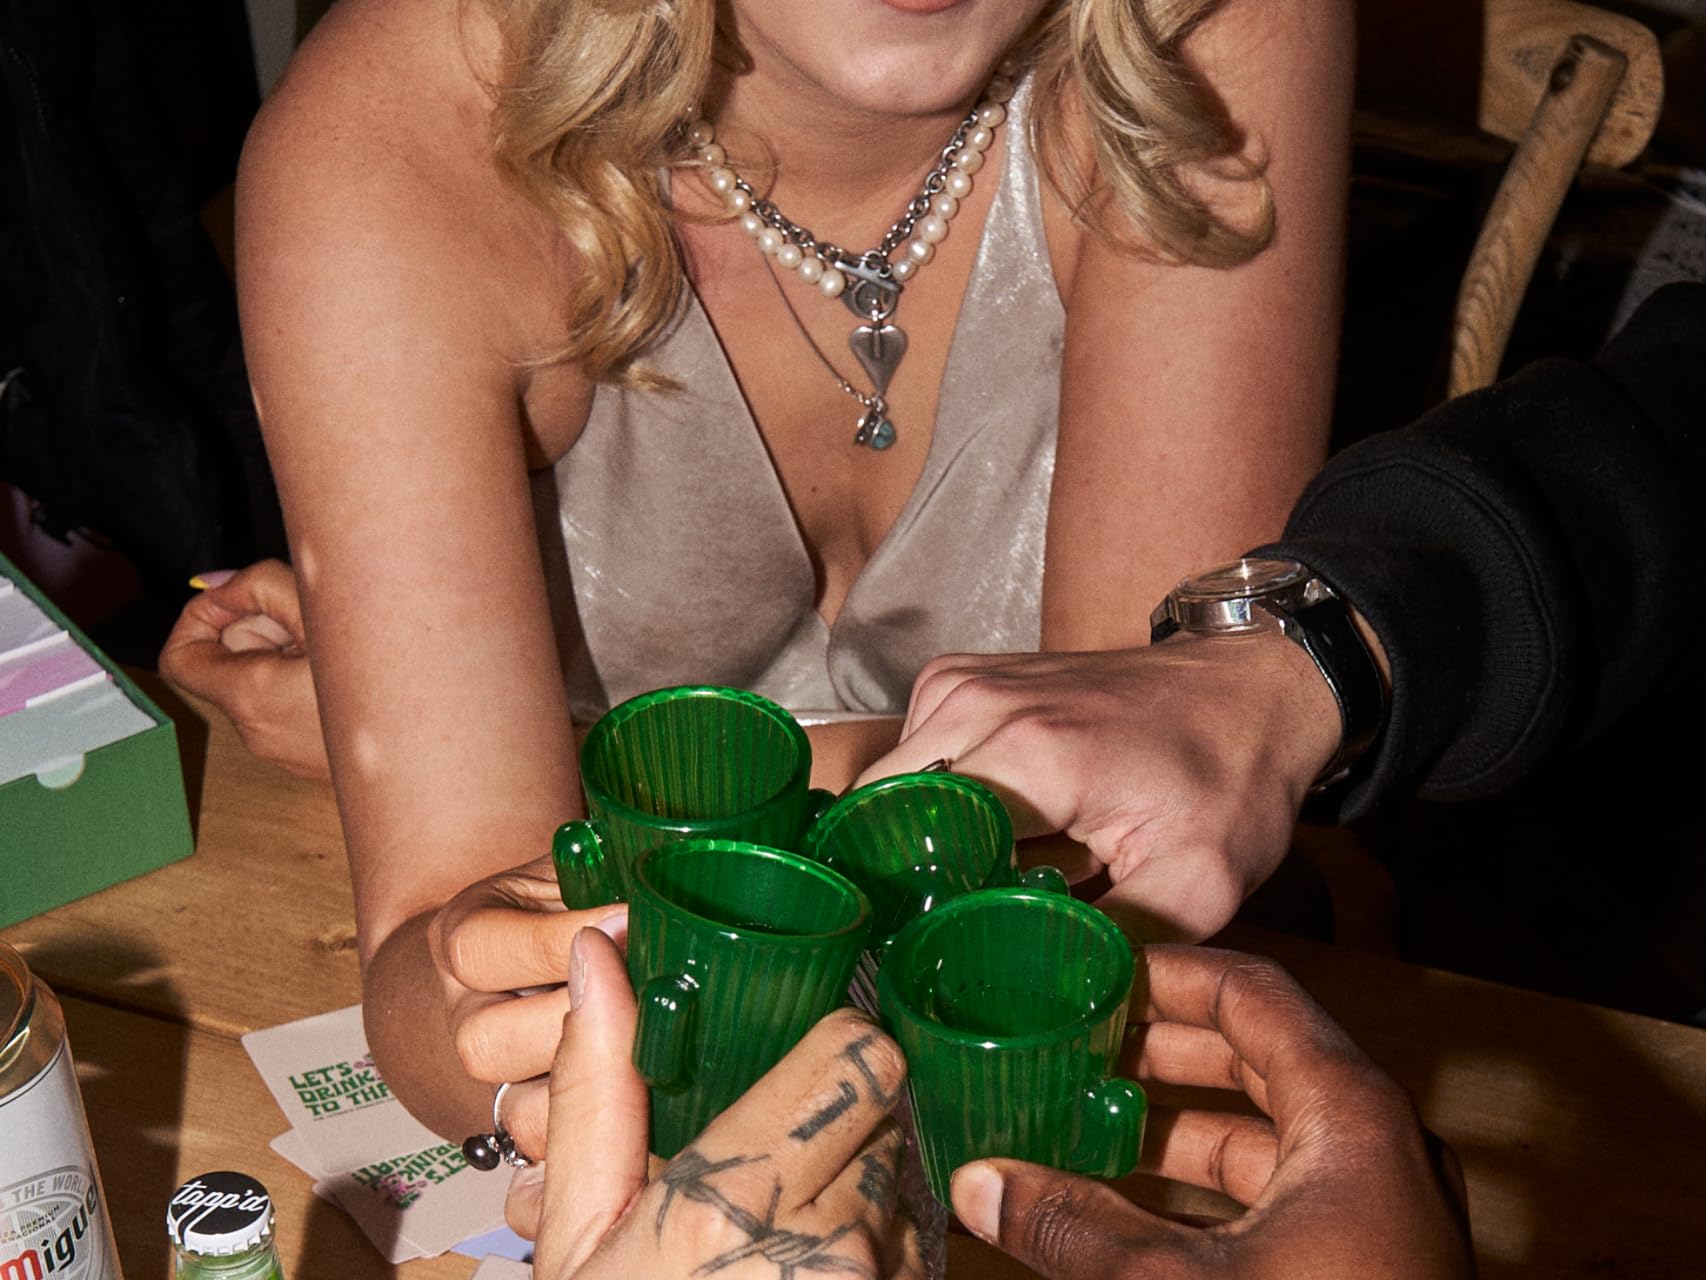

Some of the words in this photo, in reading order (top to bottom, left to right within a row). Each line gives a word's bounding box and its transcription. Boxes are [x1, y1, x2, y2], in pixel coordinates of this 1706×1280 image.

[288, 1061, 354, 1091] LET'S
[297, 1070, 375, 1104] DRINK
[305, 1100, 341, 1117] TO
[425, 1152, 470, 1185] ET'S
[11, 1180, 46, 1203] THE
